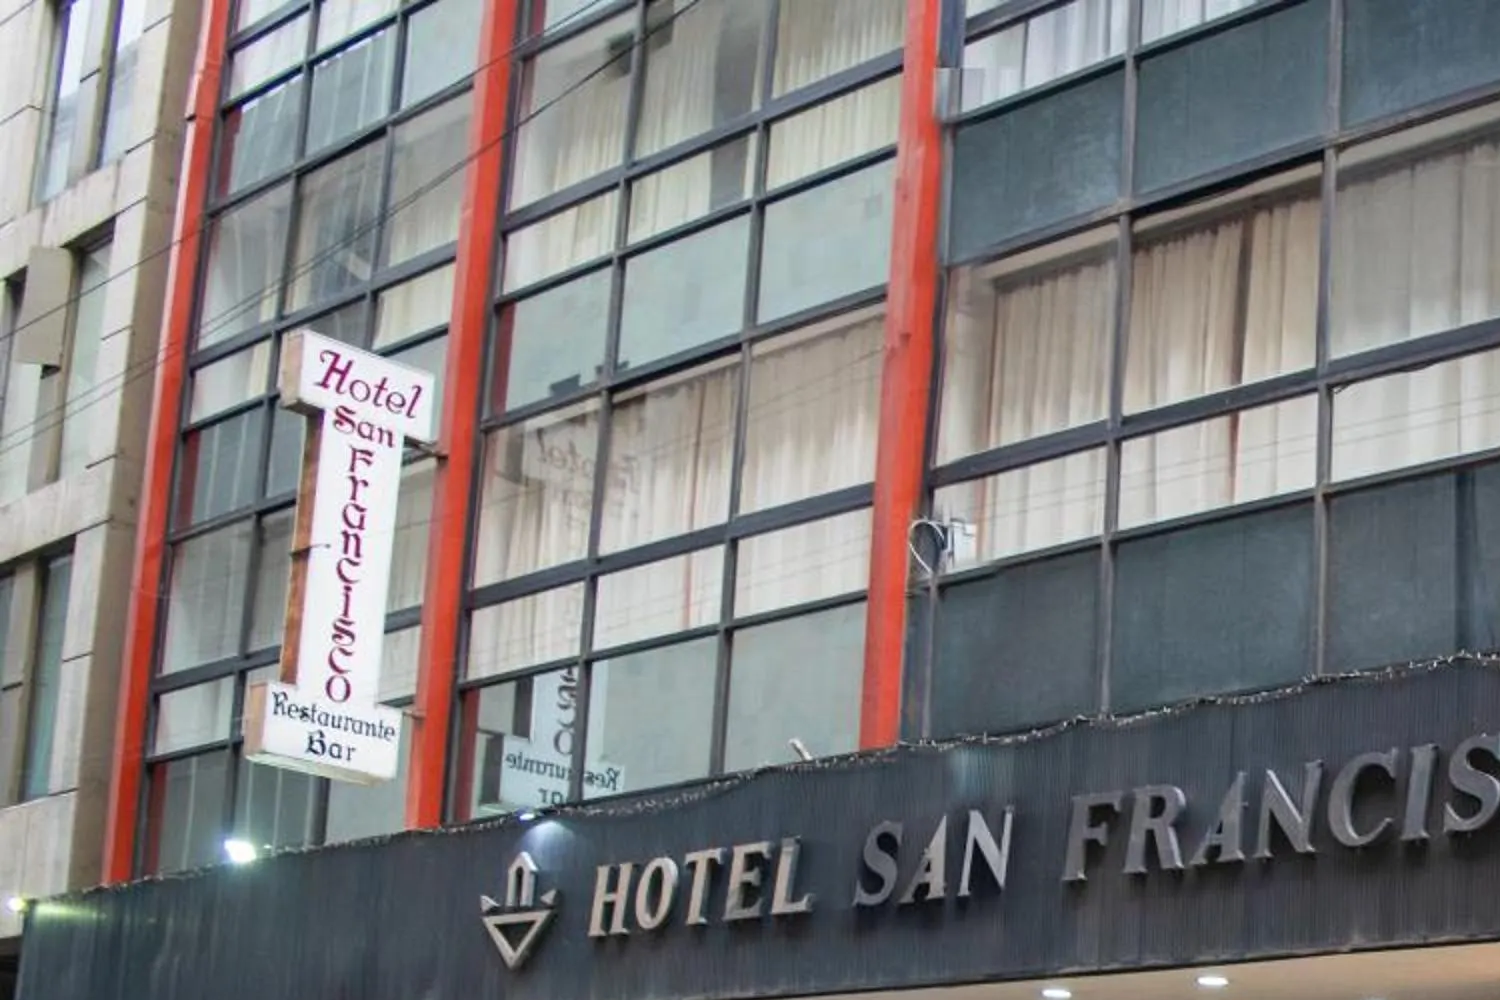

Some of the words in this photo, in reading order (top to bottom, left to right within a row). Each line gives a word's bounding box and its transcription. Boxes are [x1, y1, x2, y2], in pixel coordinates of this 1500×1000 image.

[316, 348, 423, 419] Hotel
[332, 405, 397, 449] San
[324, 446, 375, 703] Francisco
[270, 690, 397, 742] Restaurante
[305, 731, 357, 763] Bar
[587, 838, 813, 940] HOTEL
[852, 806, 1016, 907] SAN
